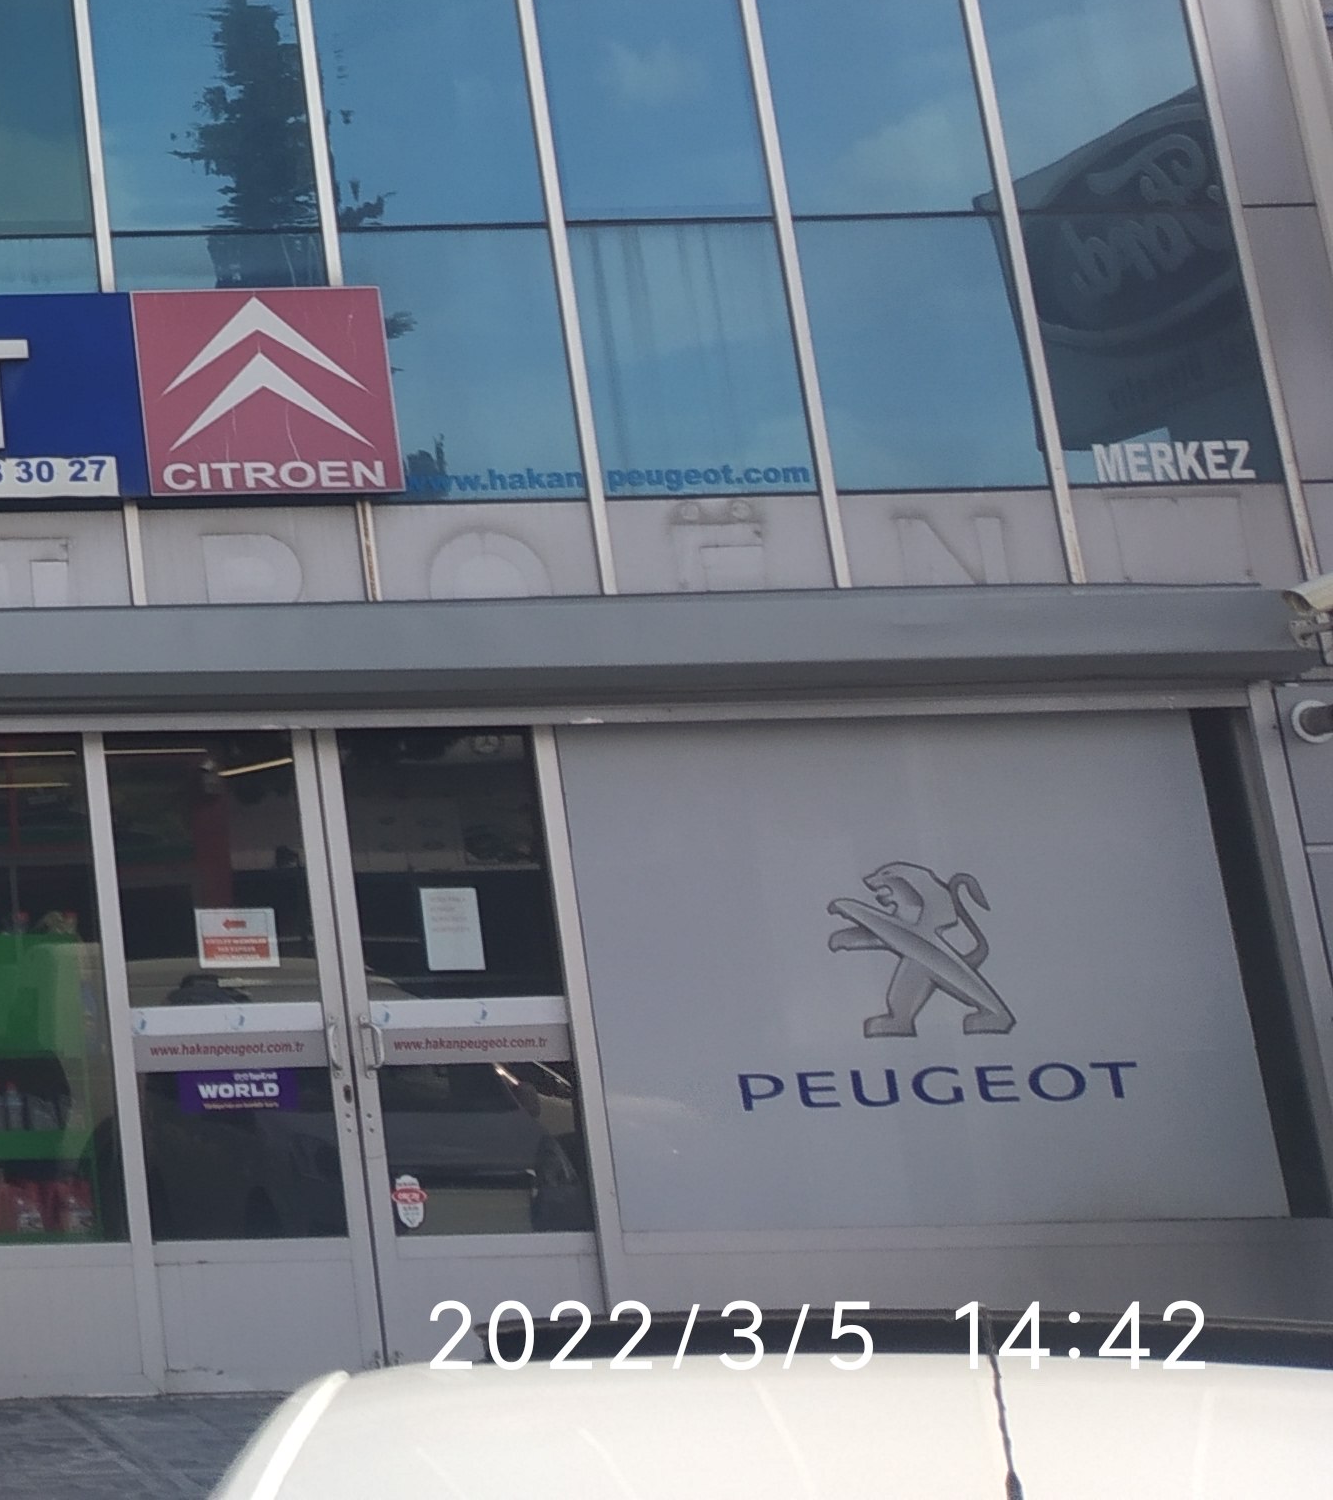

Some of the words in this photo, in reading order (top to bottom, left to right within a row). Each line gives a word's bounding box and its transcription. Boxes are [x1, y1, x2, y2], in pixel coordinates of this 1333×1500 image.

[15, 459, 55, 484] 30
[68, 458, 107, 483] 27
[162, 459, 386, 491] CITROEN
[1091, 440, 1256, 484] MERKEZ
[149, 1041, 306, 1058] www.hakanpeugeot.com.tr
[393, 1036, 548, 1052] www.hakanpeugeot.com.tr
[197, 1083, 280, 1099] WORLD
[737, 1059, 1138, 1112] PEUGEOT
